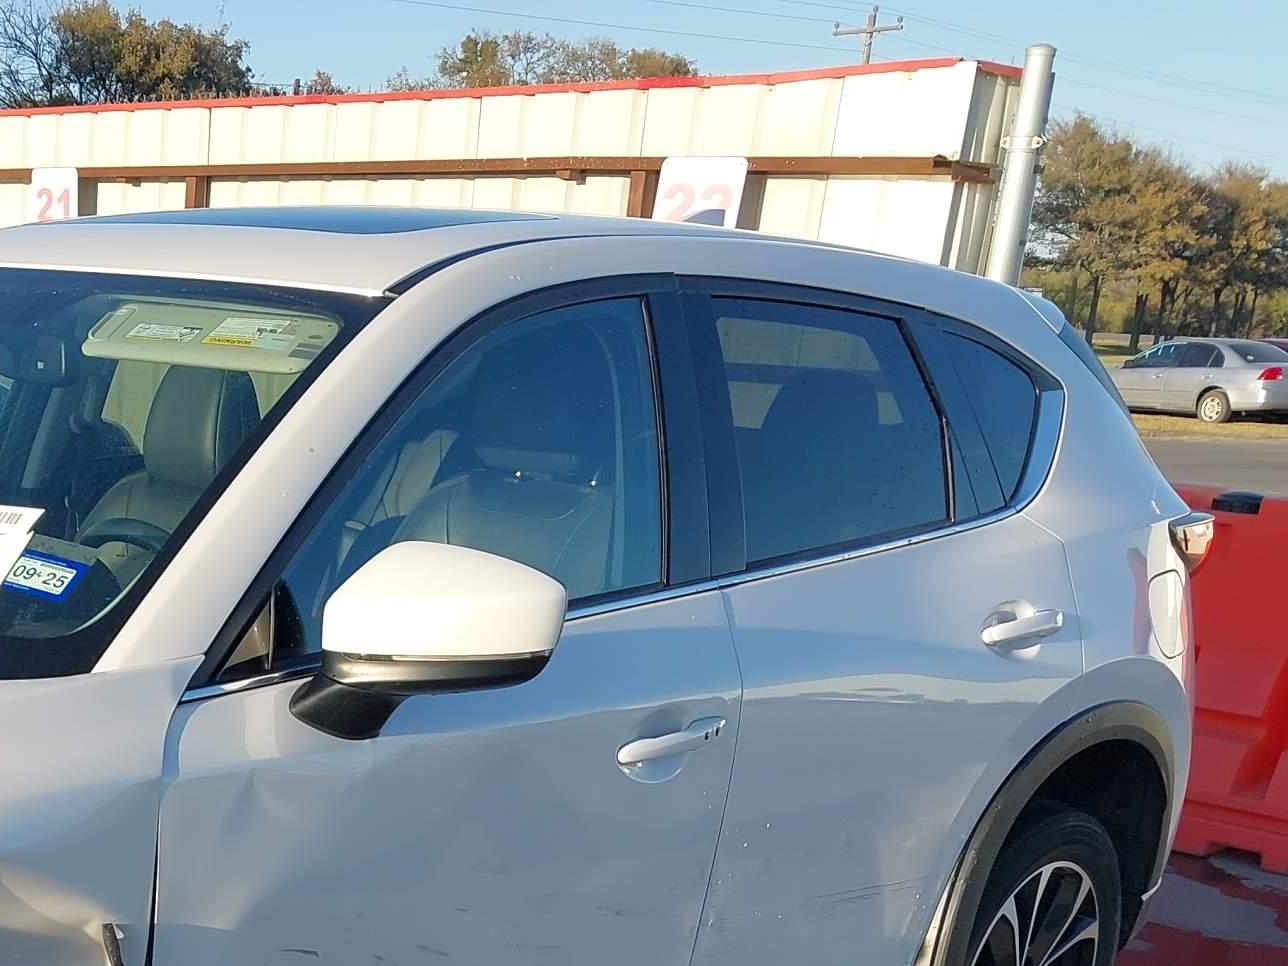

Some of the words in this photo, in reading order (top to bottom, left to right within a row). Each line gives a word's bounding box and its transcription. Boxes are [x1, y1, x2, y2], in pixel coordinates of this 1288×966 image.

[36, 187, 70, 221] 21
[663, 184, 734, 222] 22
[13, 564, 37, 581] 09
[41, 571, 69, 588] 25
